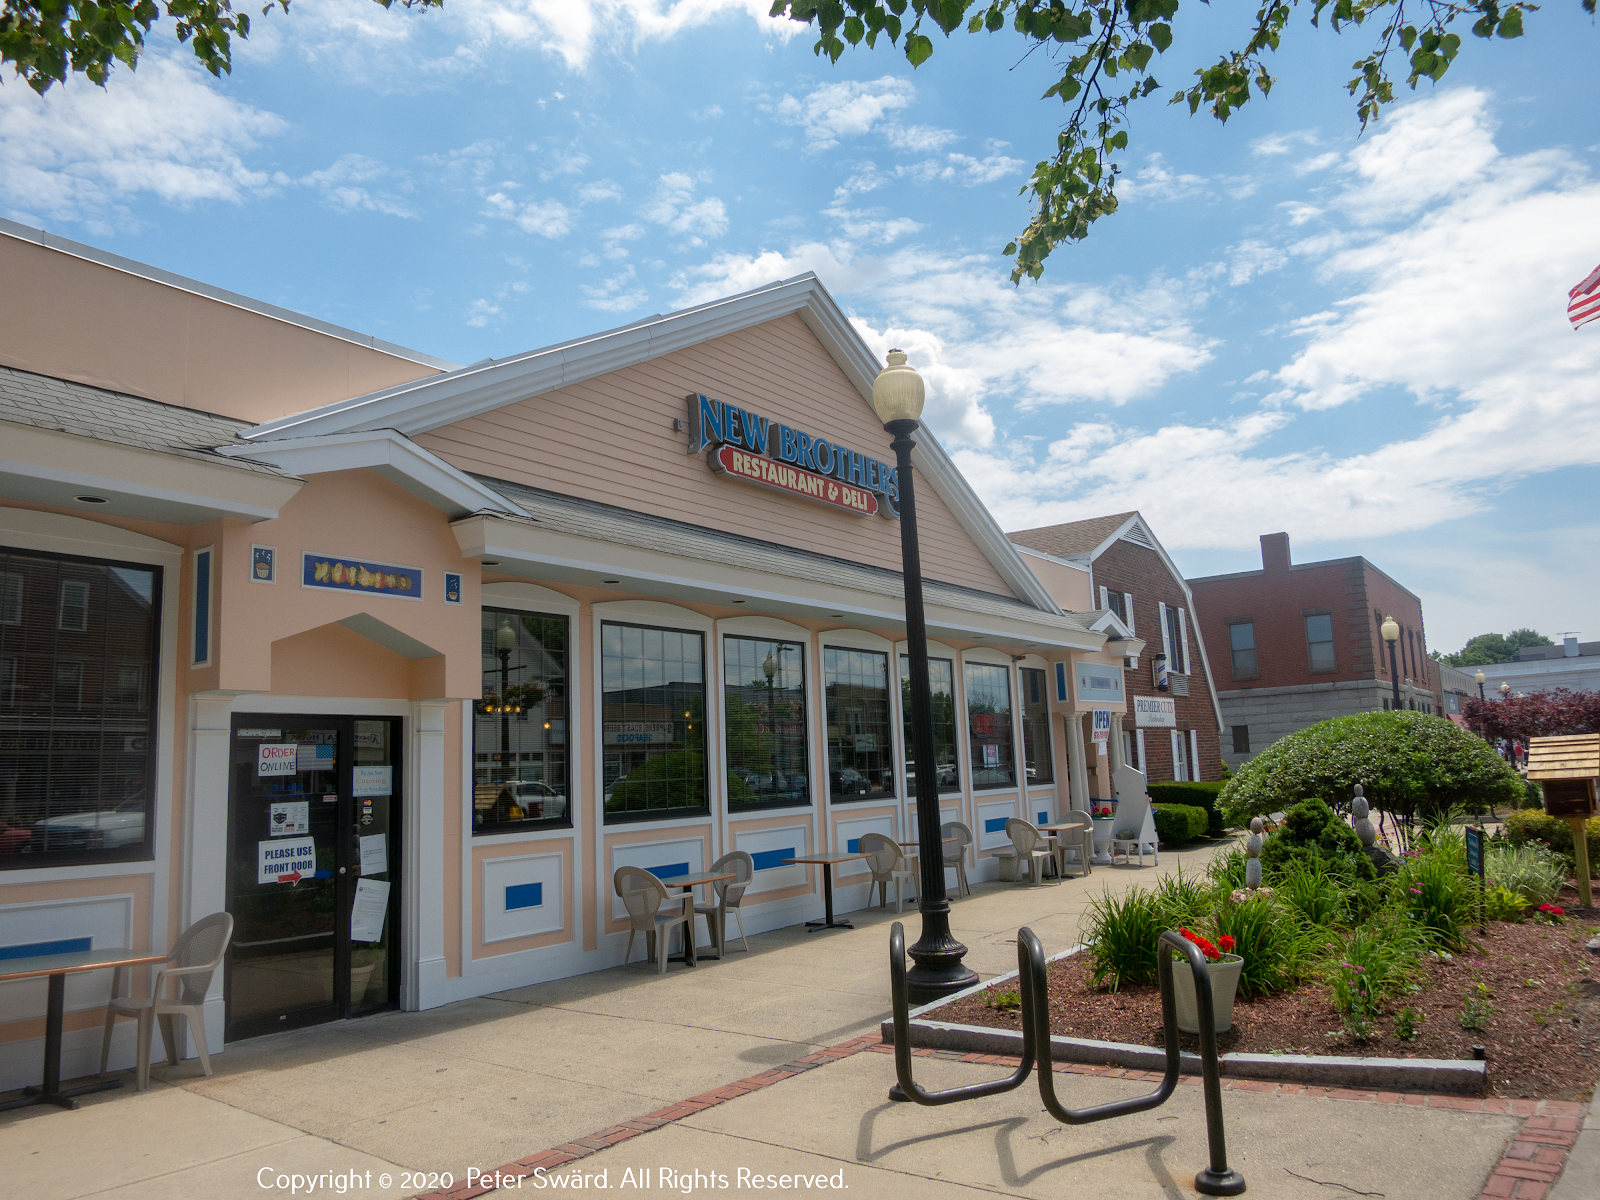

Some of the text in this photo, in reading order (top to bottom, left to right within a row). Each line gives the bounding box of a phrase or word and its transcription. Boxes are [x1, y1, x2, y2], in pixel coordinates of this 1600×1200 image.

[698, 393, 770, 454] NEW
[732, 450, 868, 511] RESTAURANT & DELI
[1136, 699, 1174, 714] PREMIER CUTS
[1094, 710, 1111, 730] OPEN
[262, 747, 295, 759] ORDER
[260, 761, 296, 772] ONLINE
[265, 846, 313, 860] PLEASE USE
[264, 860, 313, 875] FRONT DOOR
